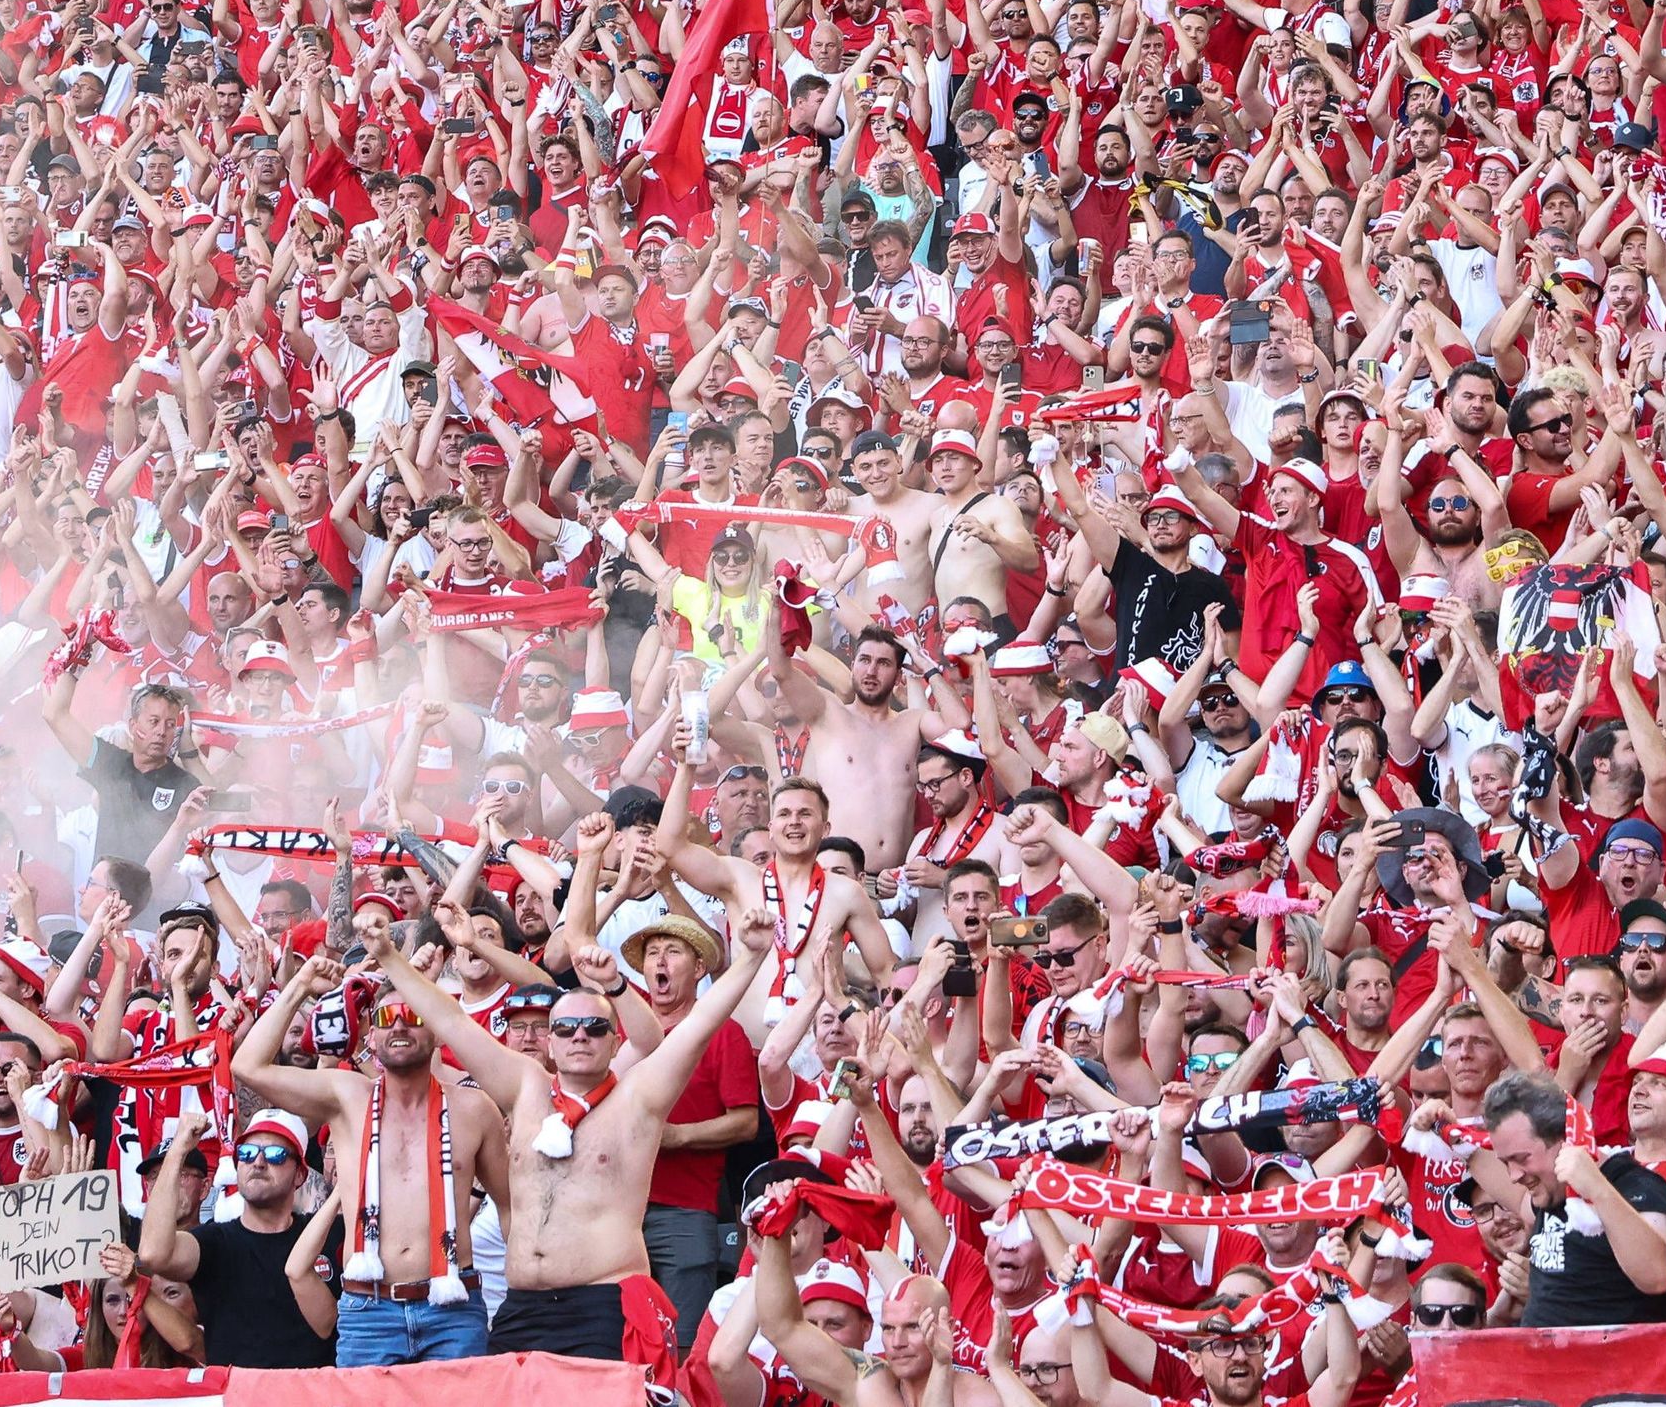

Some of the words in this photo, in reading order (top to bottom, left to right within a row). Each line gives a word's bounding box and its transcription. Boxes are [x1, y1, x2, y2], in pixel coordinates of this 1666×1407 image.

[950, 1091, 1263, 1165] ÖSTERCH
[62, 1174, 110, 1212] 19
[1034, 1161, 1379, 1223] ÖSTERREICH
[18, 1217, 60, 1249] DEIN
